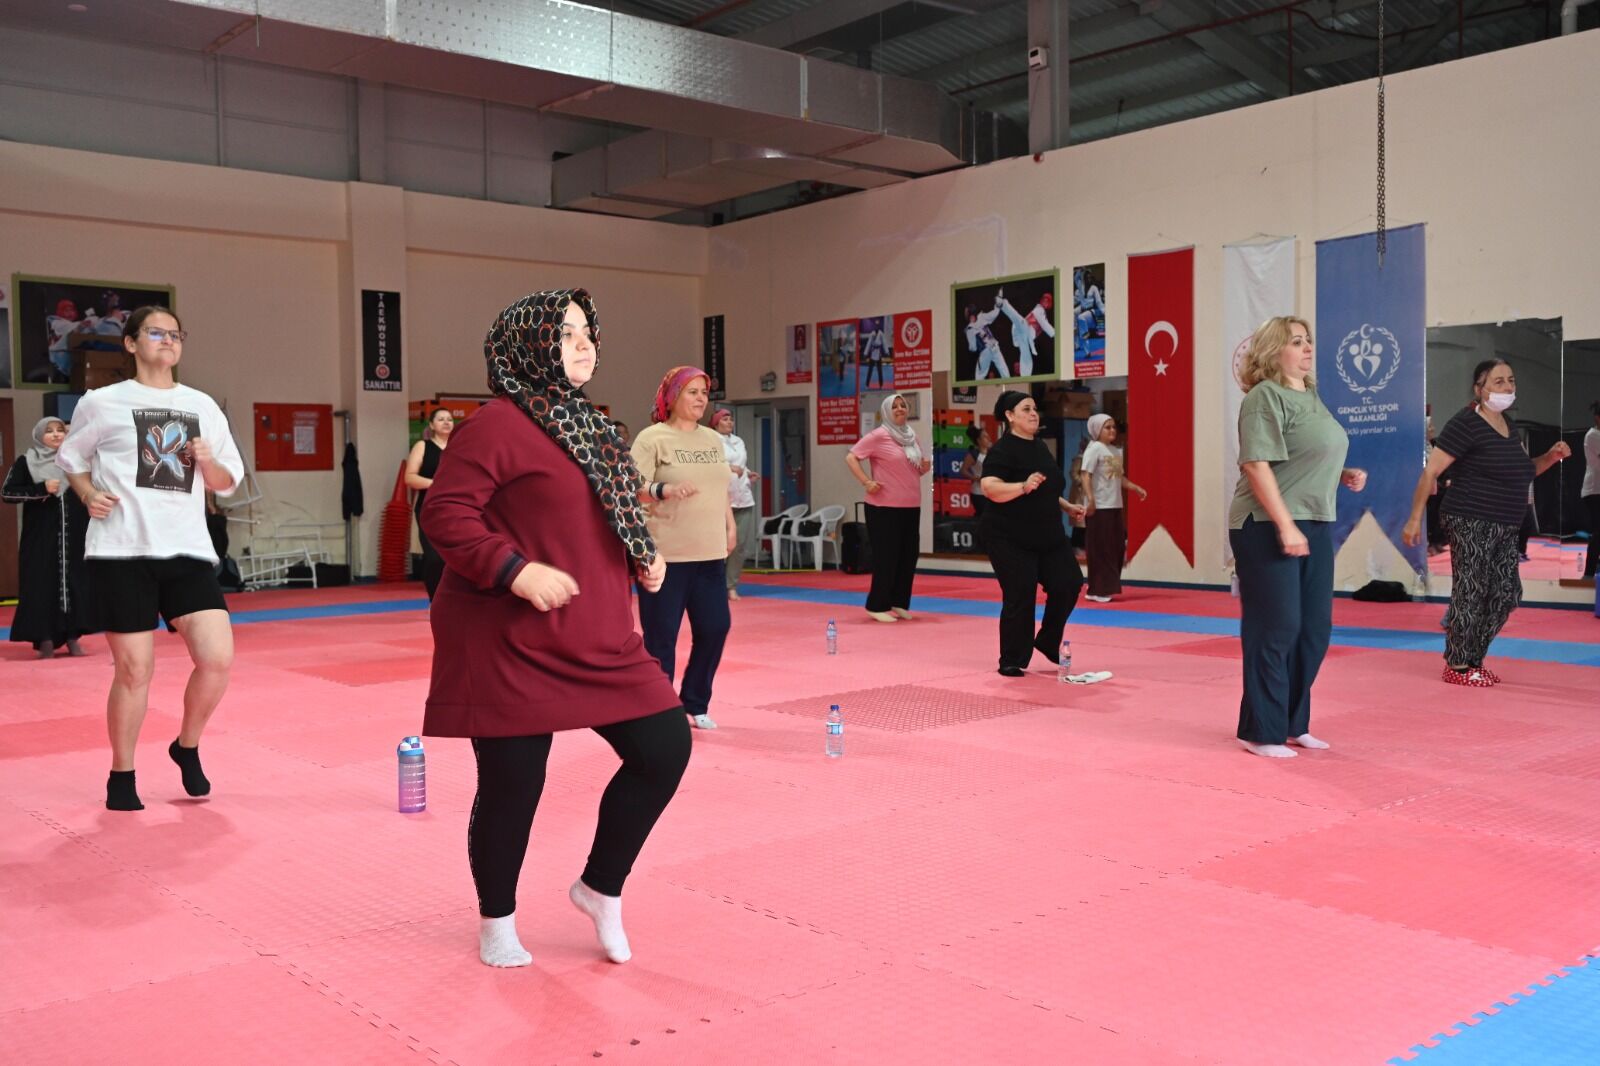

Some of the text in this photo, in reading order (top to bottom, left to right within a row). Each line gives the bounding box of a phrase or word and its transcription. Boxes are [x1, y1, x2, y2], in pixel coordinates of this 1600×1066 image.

[377, 293, 386, 364] TAEKWONDO
[364, 380, 401, 390] SANATTIR
[1368, 404, 1377, 413] VE
[1379, 403, 1399, 412] SPOR
